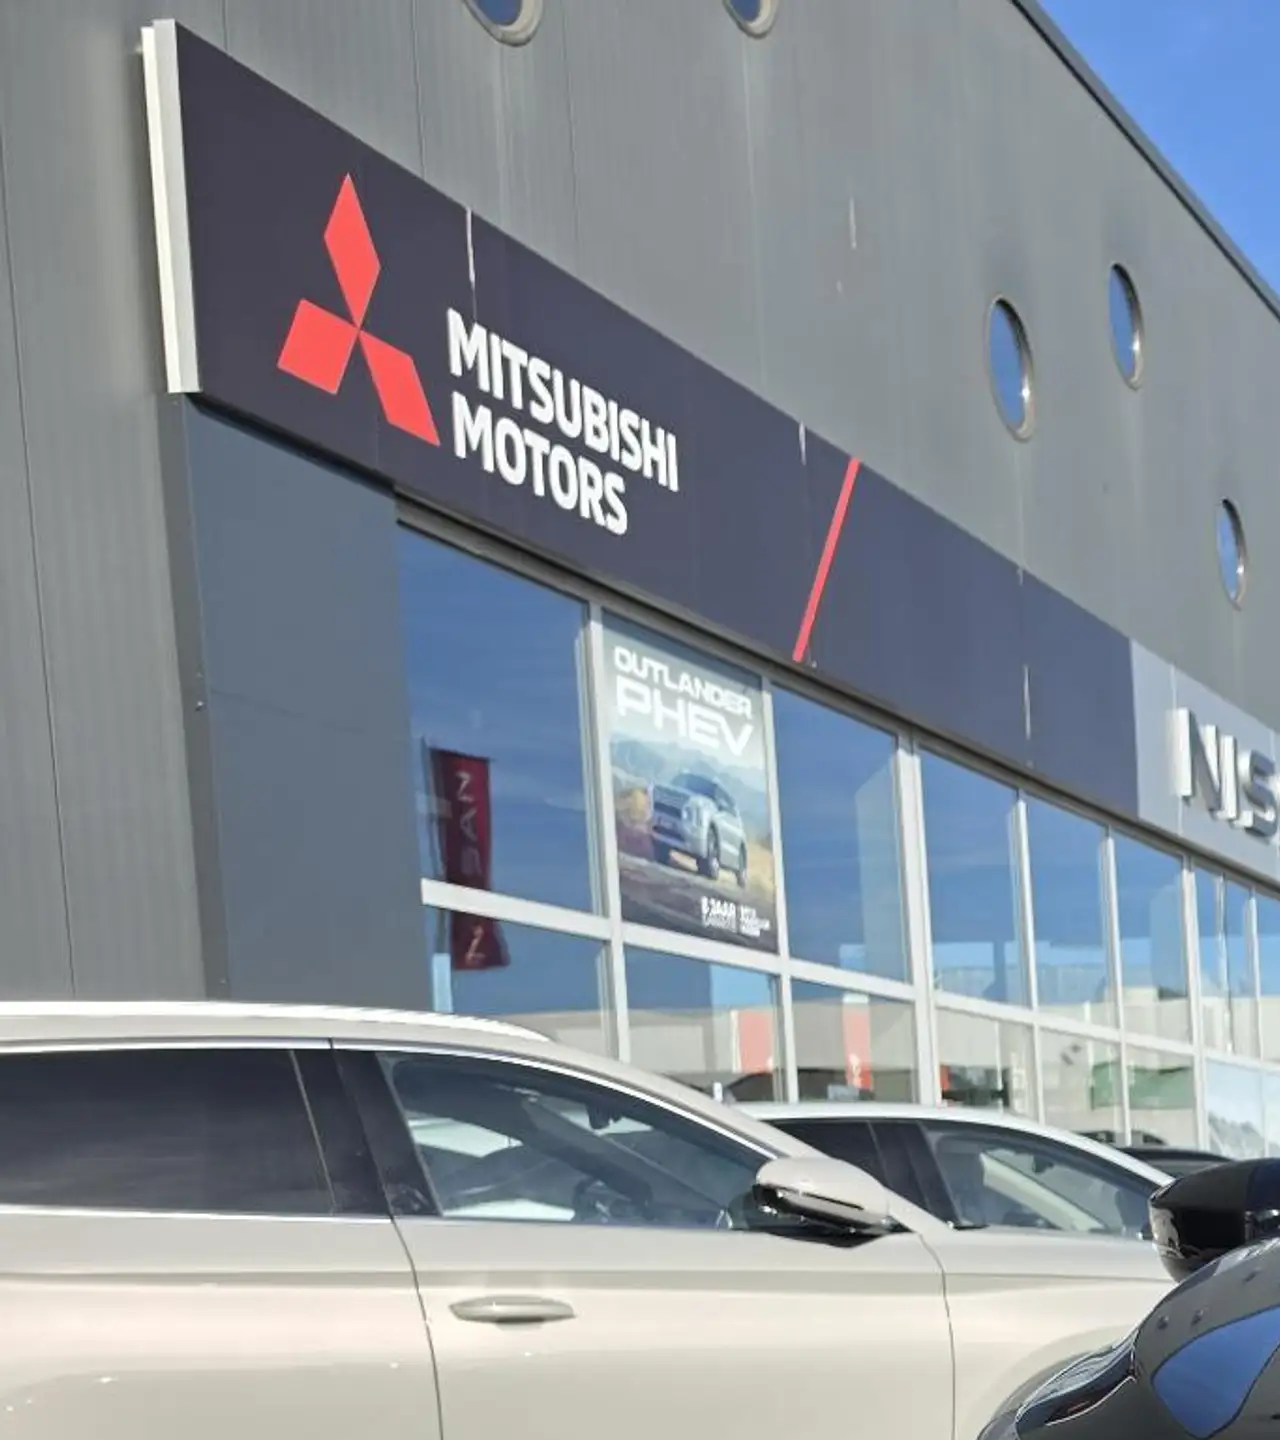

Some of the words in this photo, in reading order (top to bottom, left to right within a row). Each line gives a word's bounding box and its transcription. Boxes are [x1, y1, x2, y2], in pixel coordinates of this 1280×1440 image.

[447, 307, 679, 493] MITSUBISHI
[452, 391, 629, 535] MOTORS
[614, 645, 754, 720] OUTLANDER
[615, 675, 755, 757] PHEV
